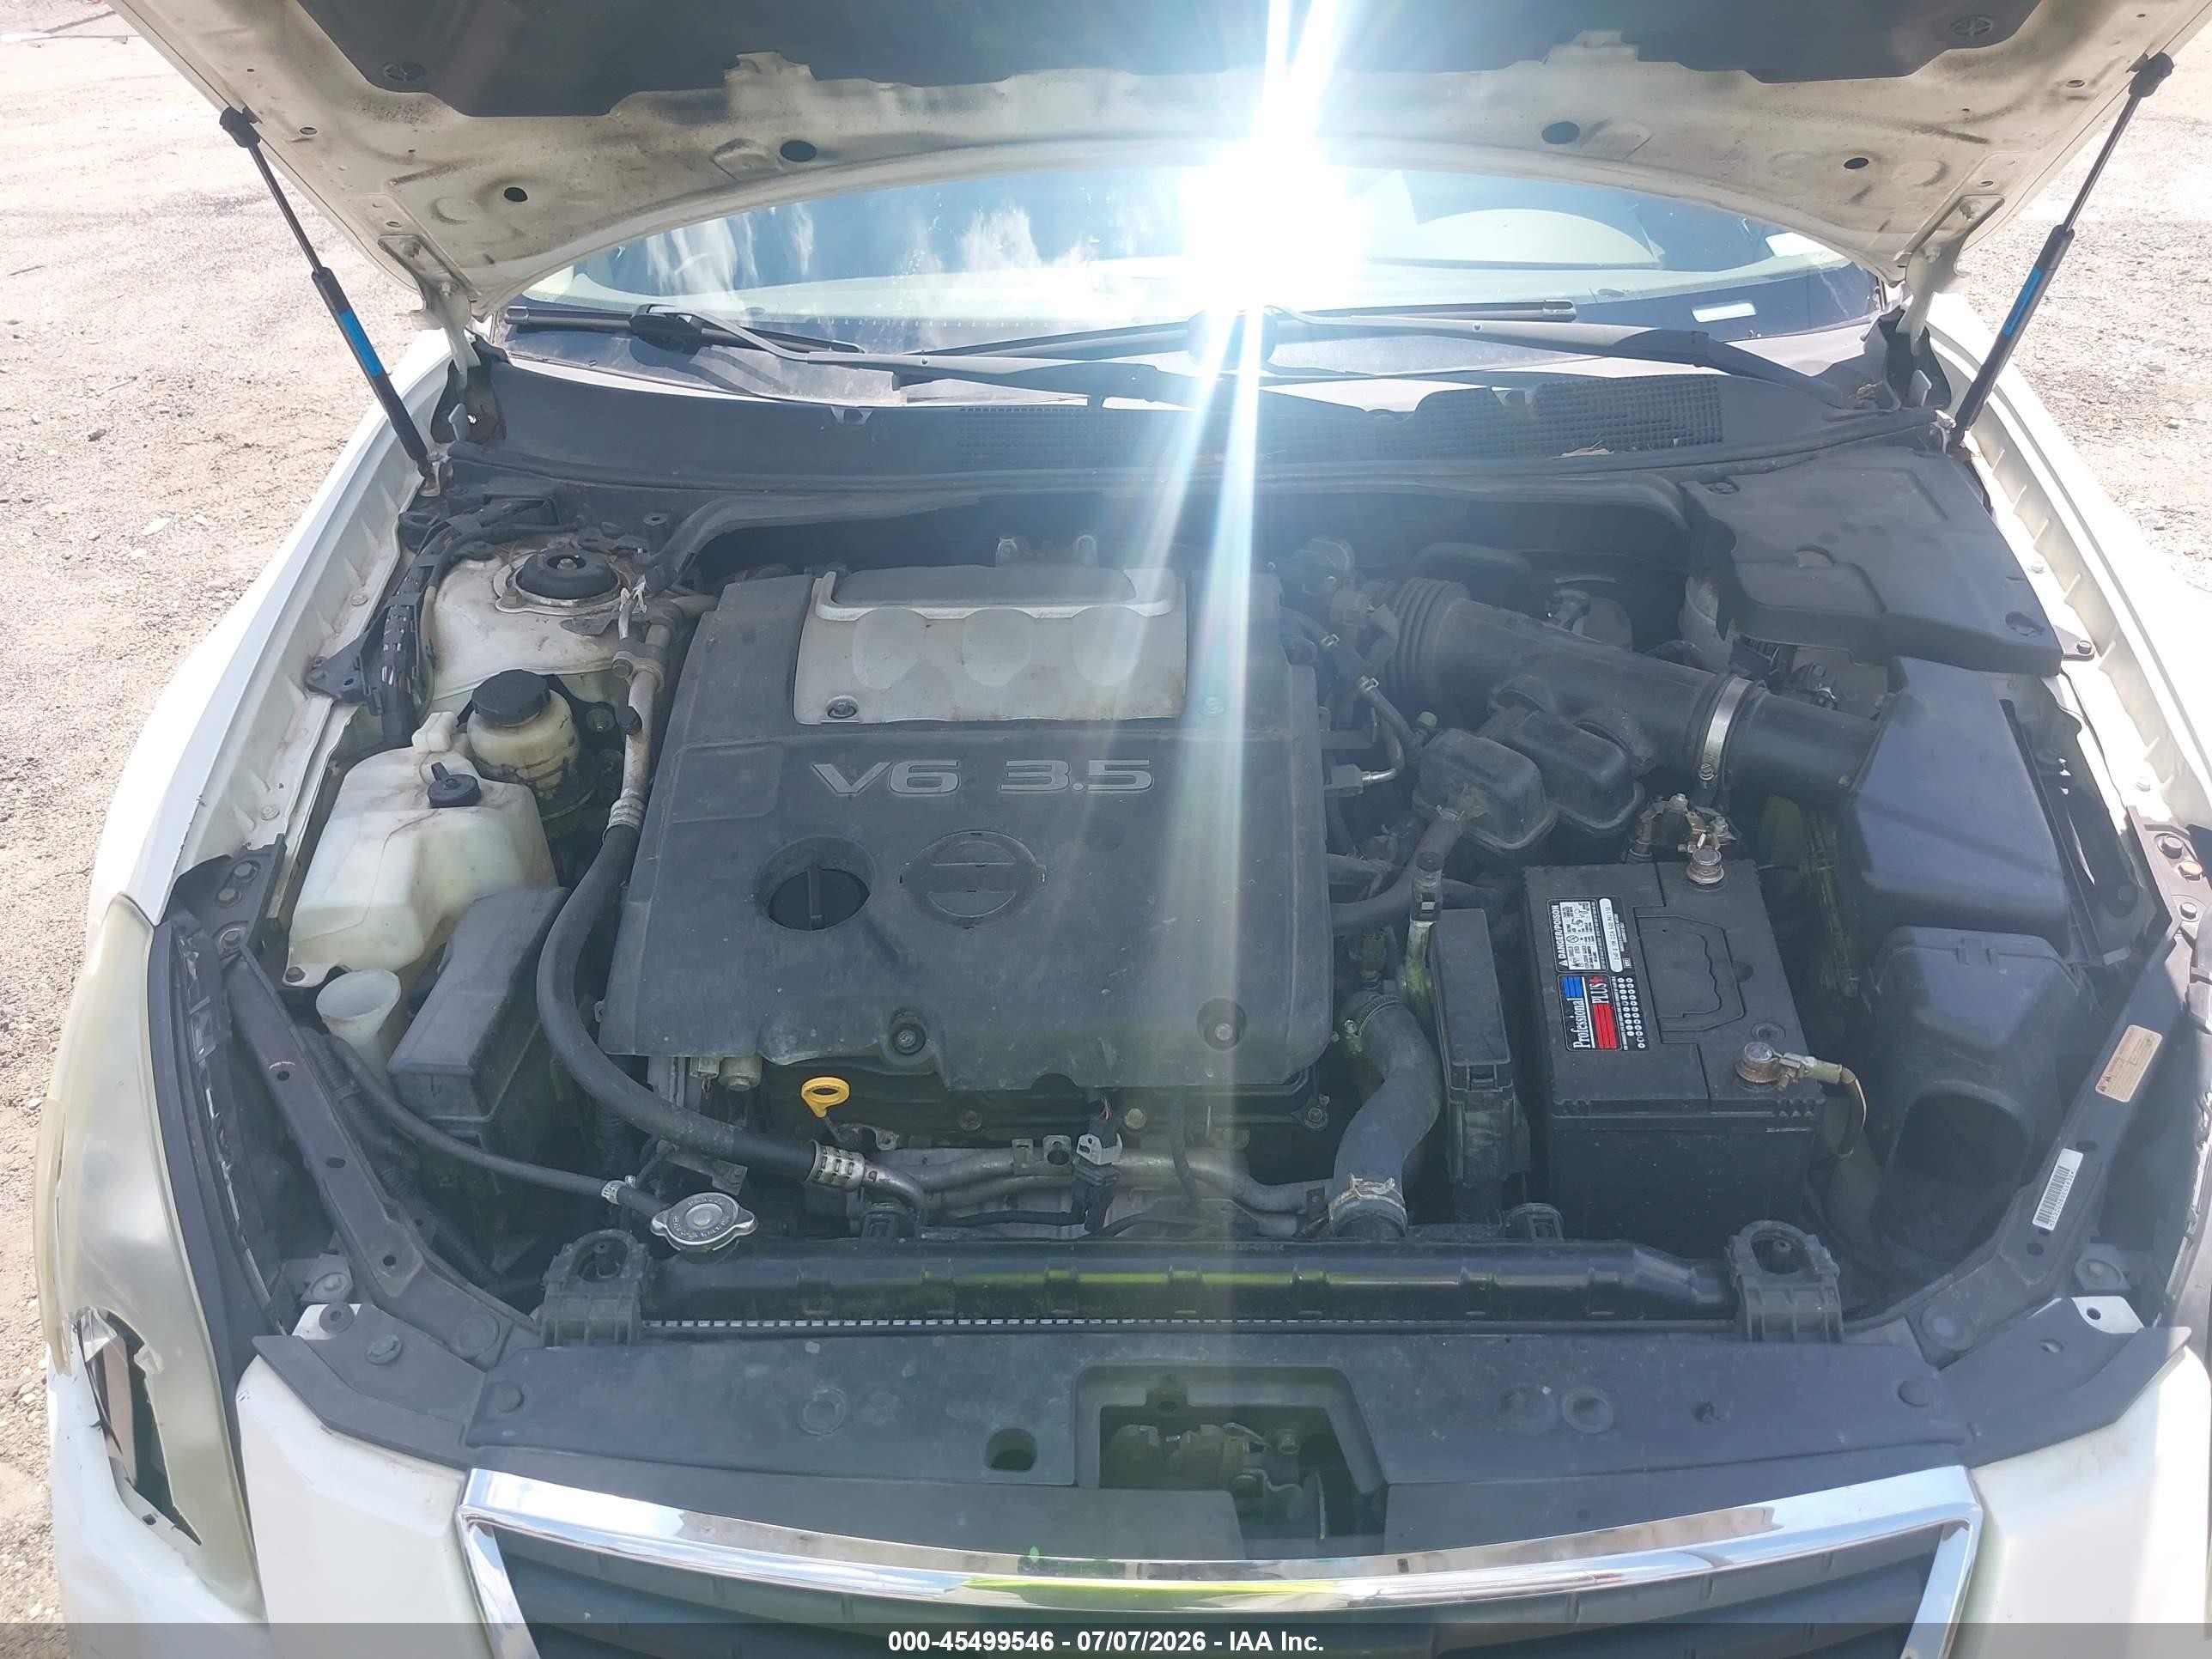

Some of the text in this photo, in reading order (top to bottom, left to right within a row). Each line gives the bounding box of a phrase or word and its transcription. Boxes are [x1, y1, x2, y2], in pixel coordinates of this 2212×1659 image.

[811, 759, 1155, 794] V6 3.5
[1551, 904, 1567, 959] DANGER/POISON
[1589, 982, 1610, 1004] PLUS
[1566, 997, 1591, 1048] Professional
